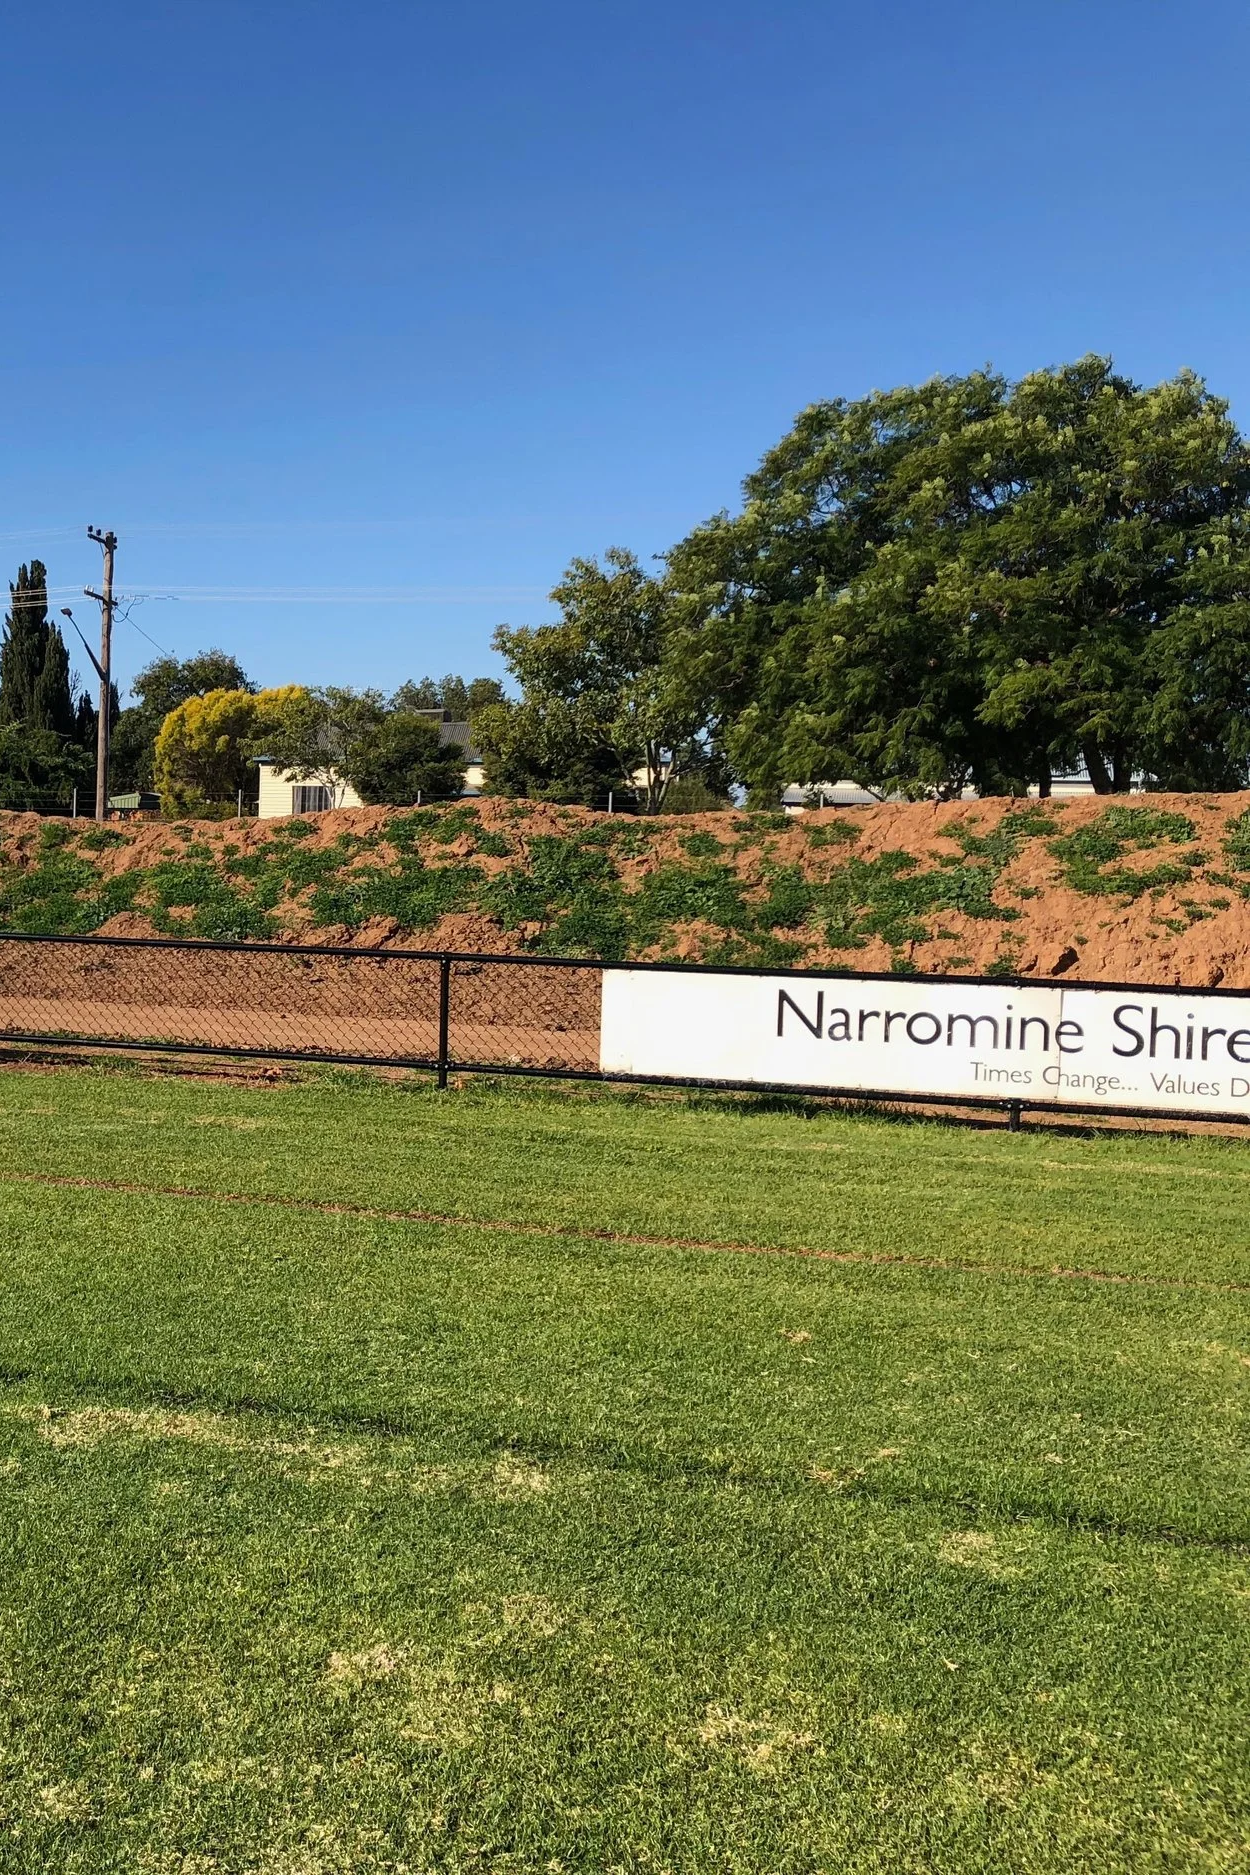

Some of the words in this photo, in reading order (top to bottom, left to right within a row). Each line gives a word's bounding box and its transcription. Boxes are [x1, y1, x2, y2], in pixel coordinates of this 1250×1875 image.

[776, 988, 1084, 1054] Narromine
[1112, 1004, 1250, 1064] Shire
[970, 1061, 1032, 1085] Times
[1042, 1065, 1138, 1095] Change...
[1150, 1073, 1220, 1098] Values
